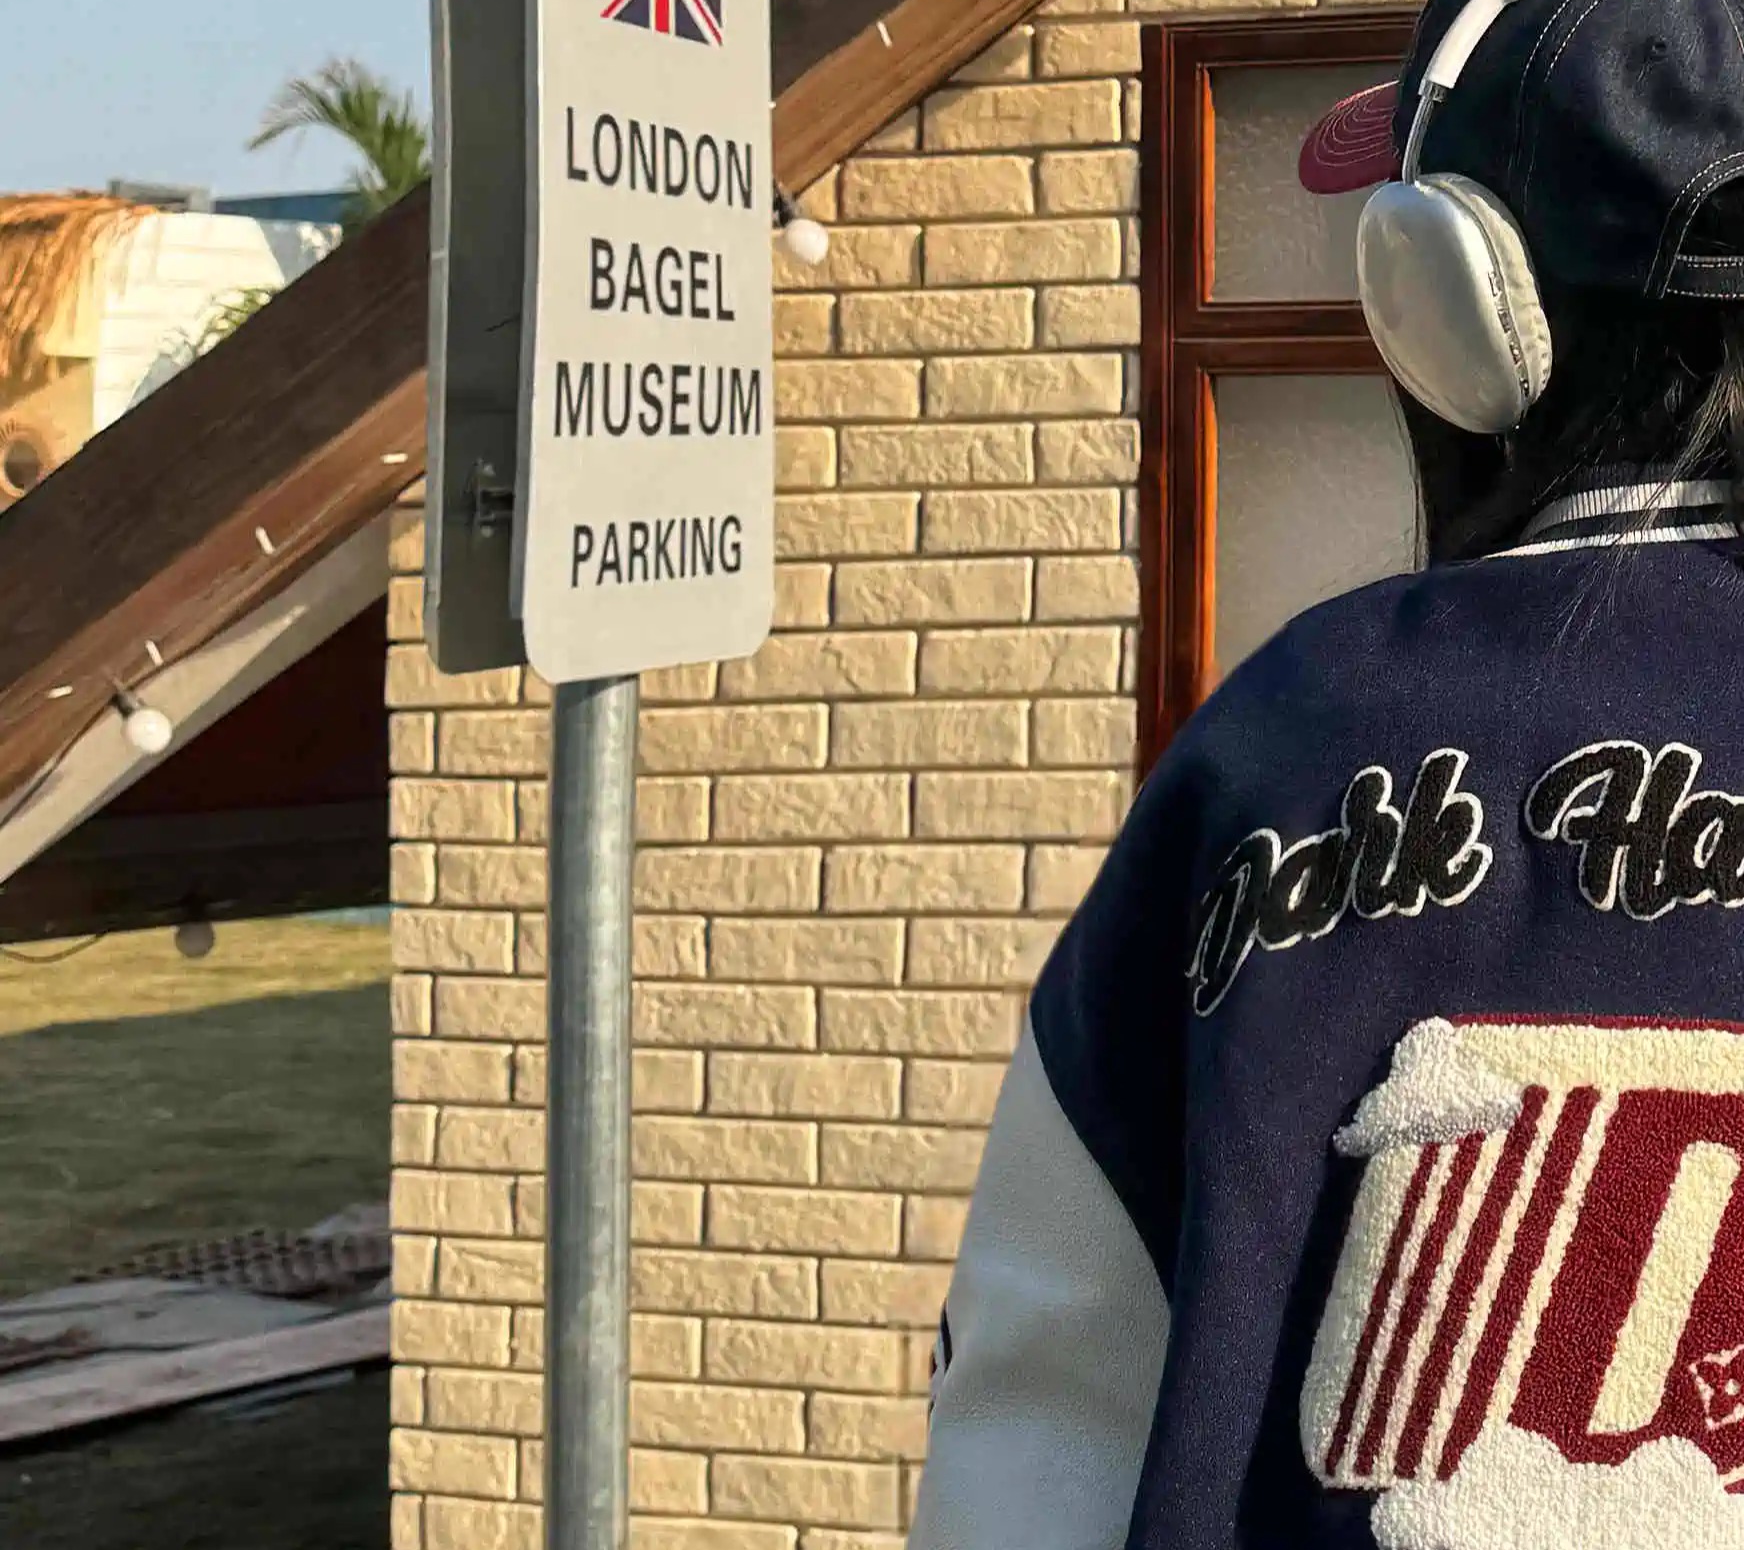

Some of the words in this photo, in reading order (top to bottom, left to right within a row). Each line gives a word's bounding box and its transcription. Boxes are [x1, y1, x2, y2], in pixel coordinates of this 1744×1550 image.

[565, 106, 753, 210] LONDON
[589, 236, 736, 322] BAGEL
[552, 360, 763, 438] MUSEUM
[570, 514, 743, 588] PARKING
